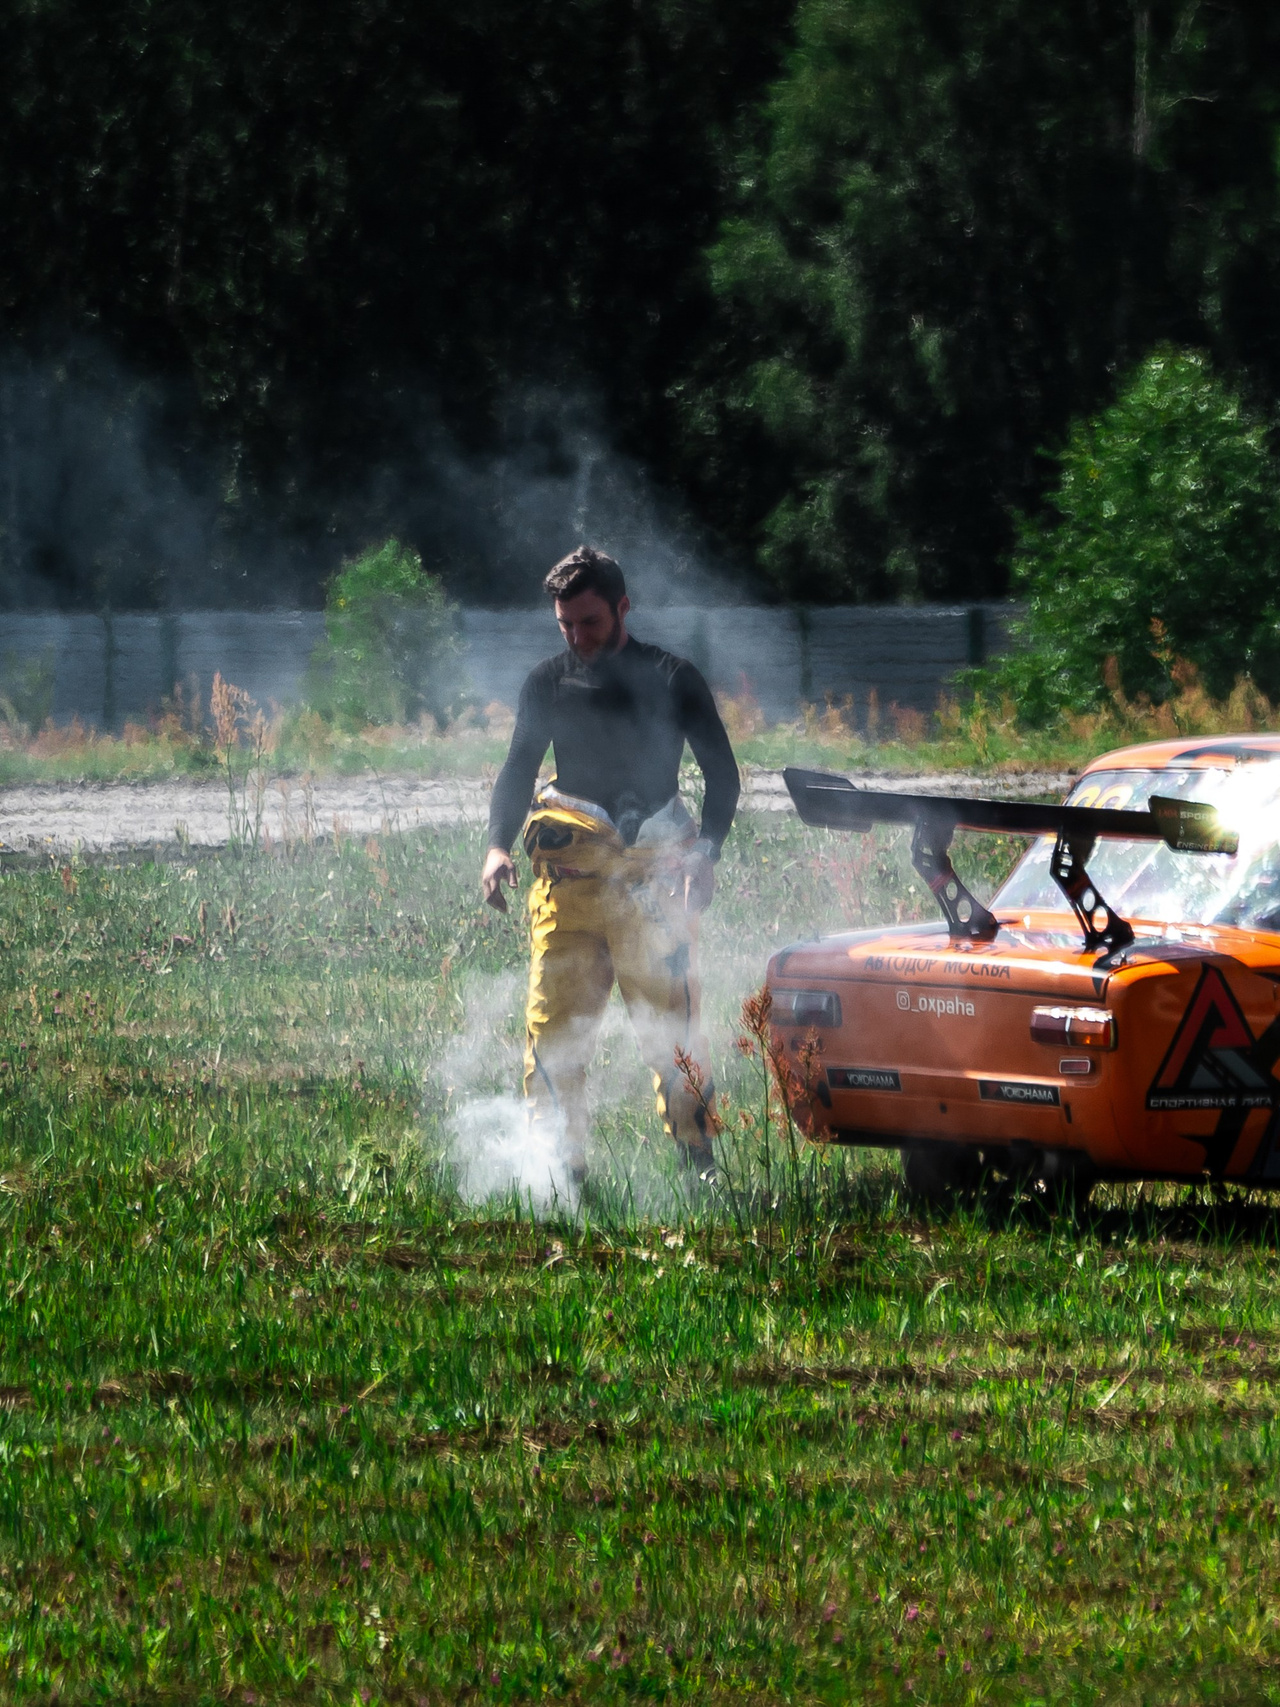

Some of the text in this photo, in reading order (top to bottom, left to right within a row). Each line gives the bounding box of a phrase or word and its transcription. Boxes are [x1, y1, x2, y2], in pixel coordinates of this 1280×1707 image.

[864, 956, 1011, 980] АВТОДОР МОСКВА
[846, 1073, 896, 1088] YOKOHAMA
[1000, 1085, 1055, 1103] YOKOHAMA
[1150, 1096, 1272, 1108] СПОРТИВНАЯ ЛИГА
